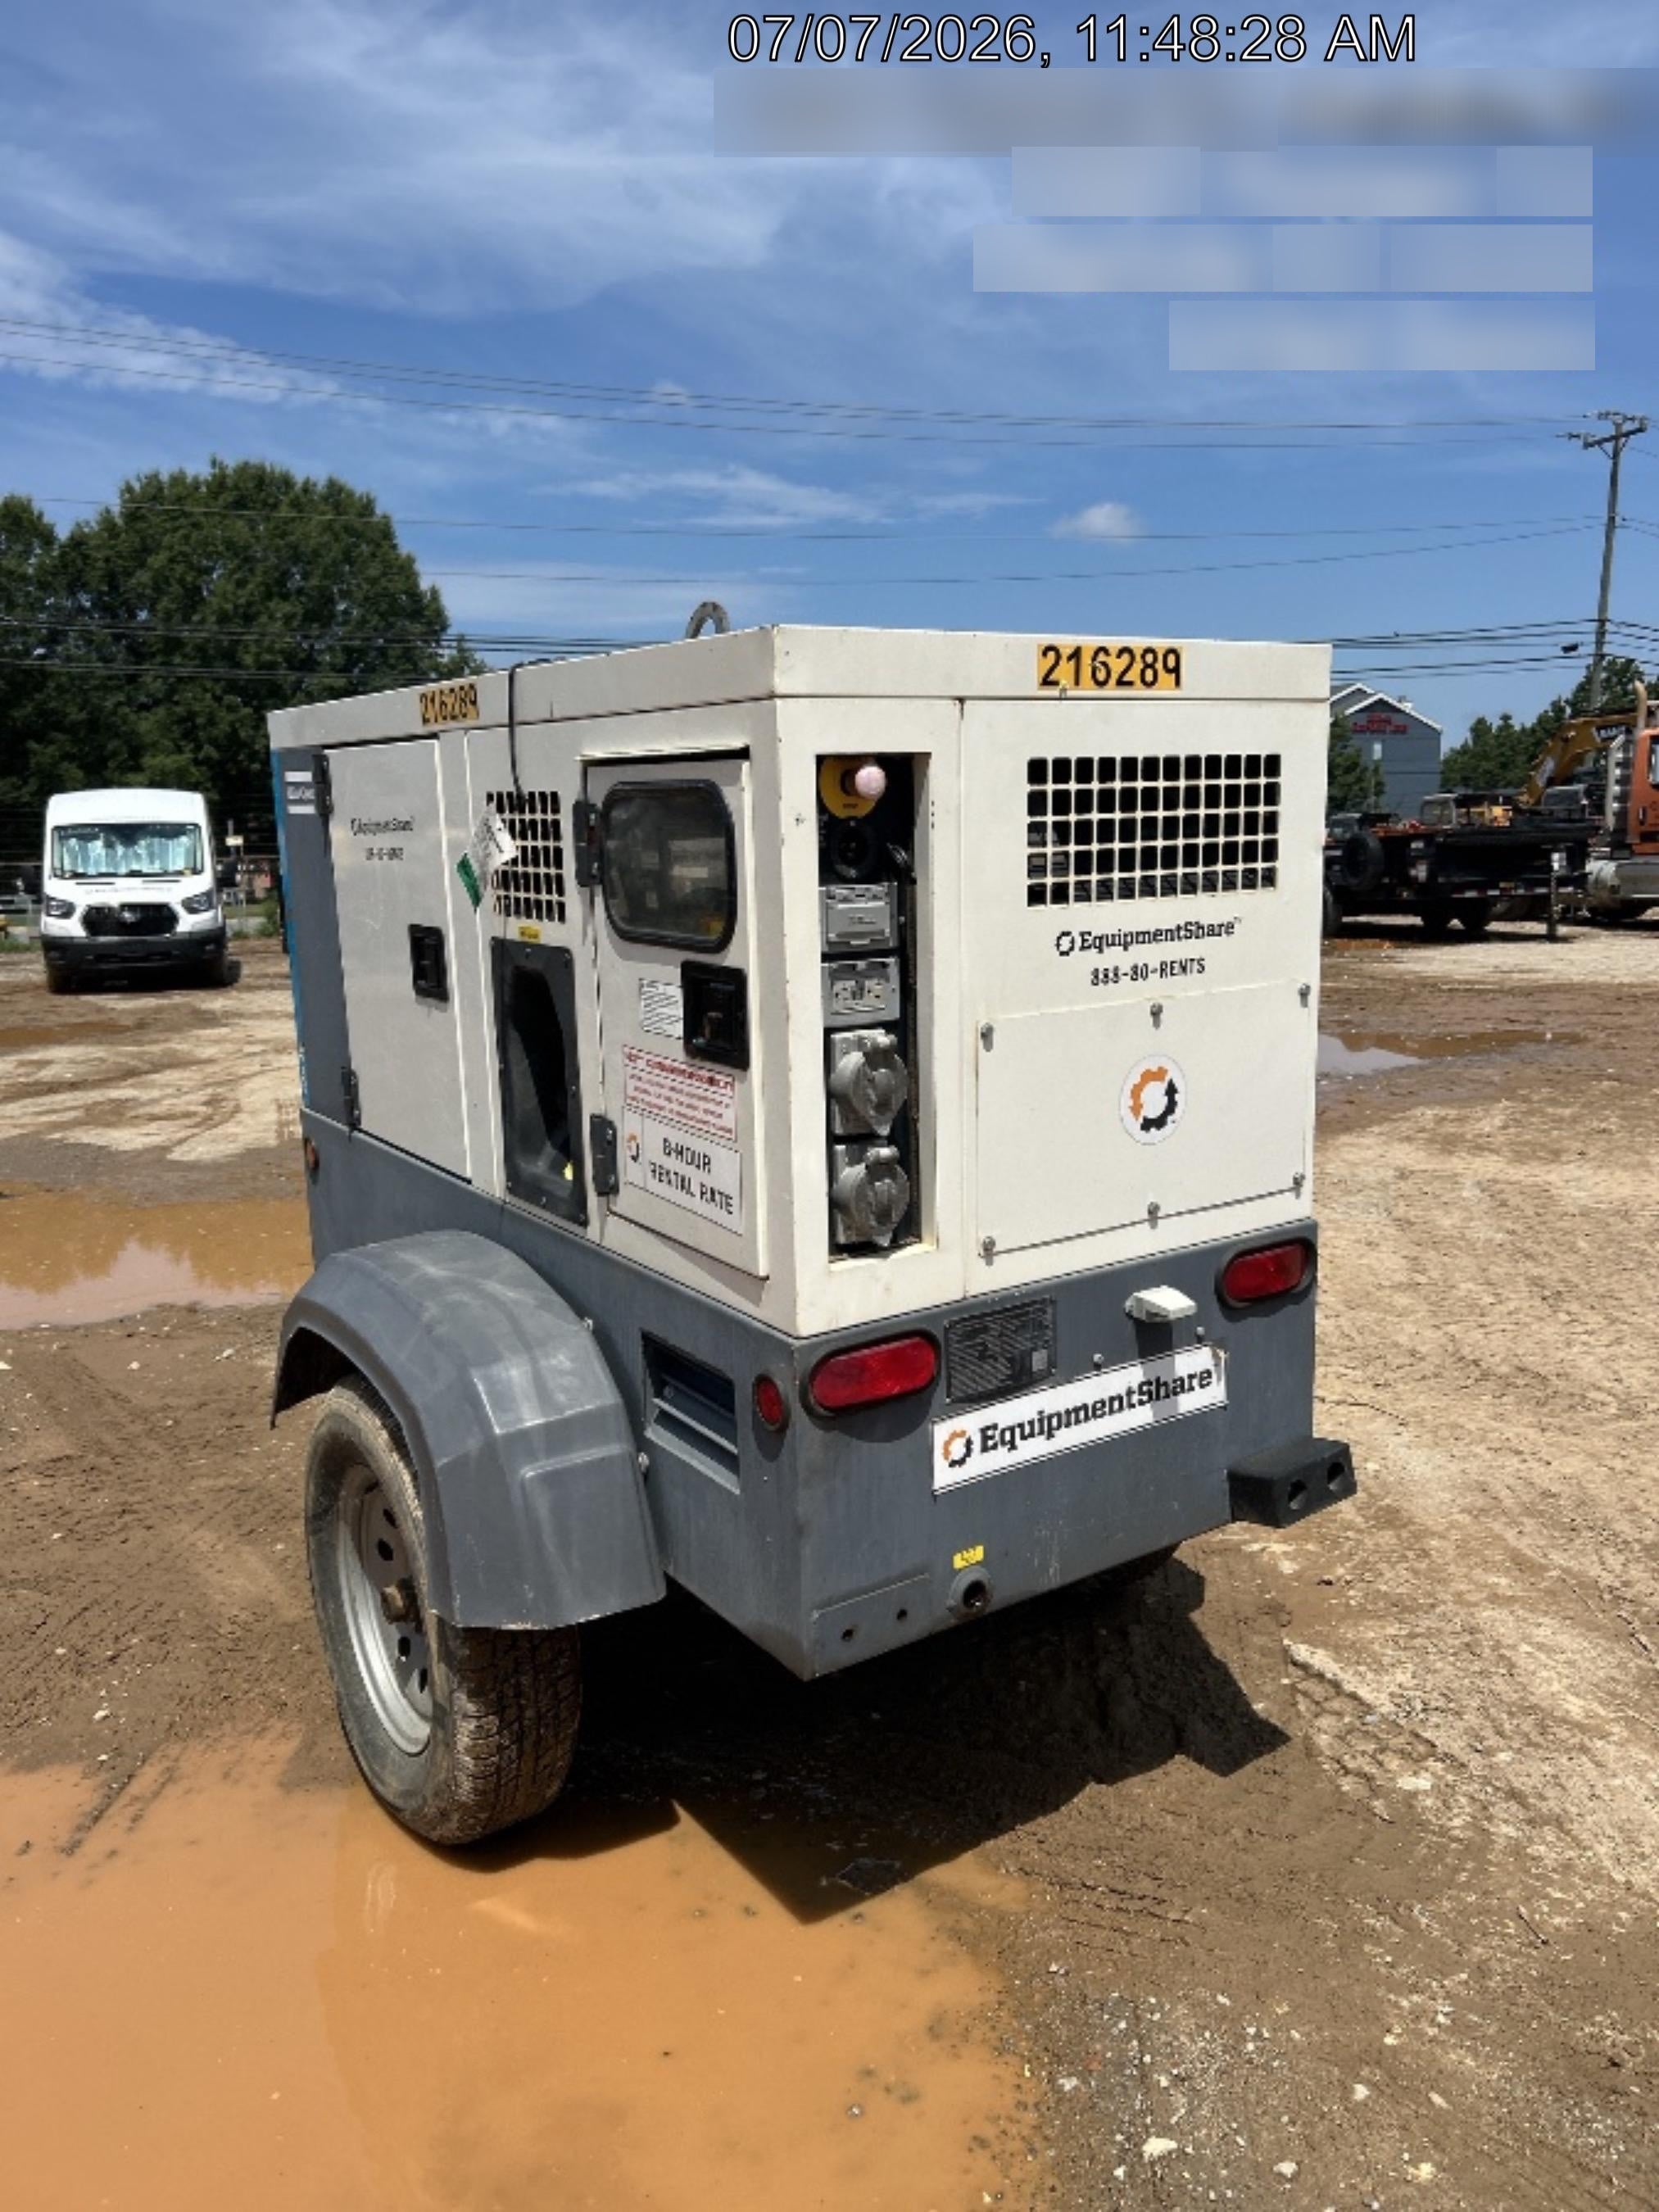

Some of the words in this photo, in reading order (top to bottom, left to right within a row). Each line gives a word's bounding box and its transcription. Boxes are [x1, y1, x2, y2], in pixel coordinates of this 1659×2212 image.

[1039, 643, 1182, 688] 216289
[419, 682, 479, 726] 216289
[1079, 921, 1235, 954] EquipmentShare
[699, 1181, 734, 1216] RATE
[979, 1367, 1213, 1454] EquipmentShare
